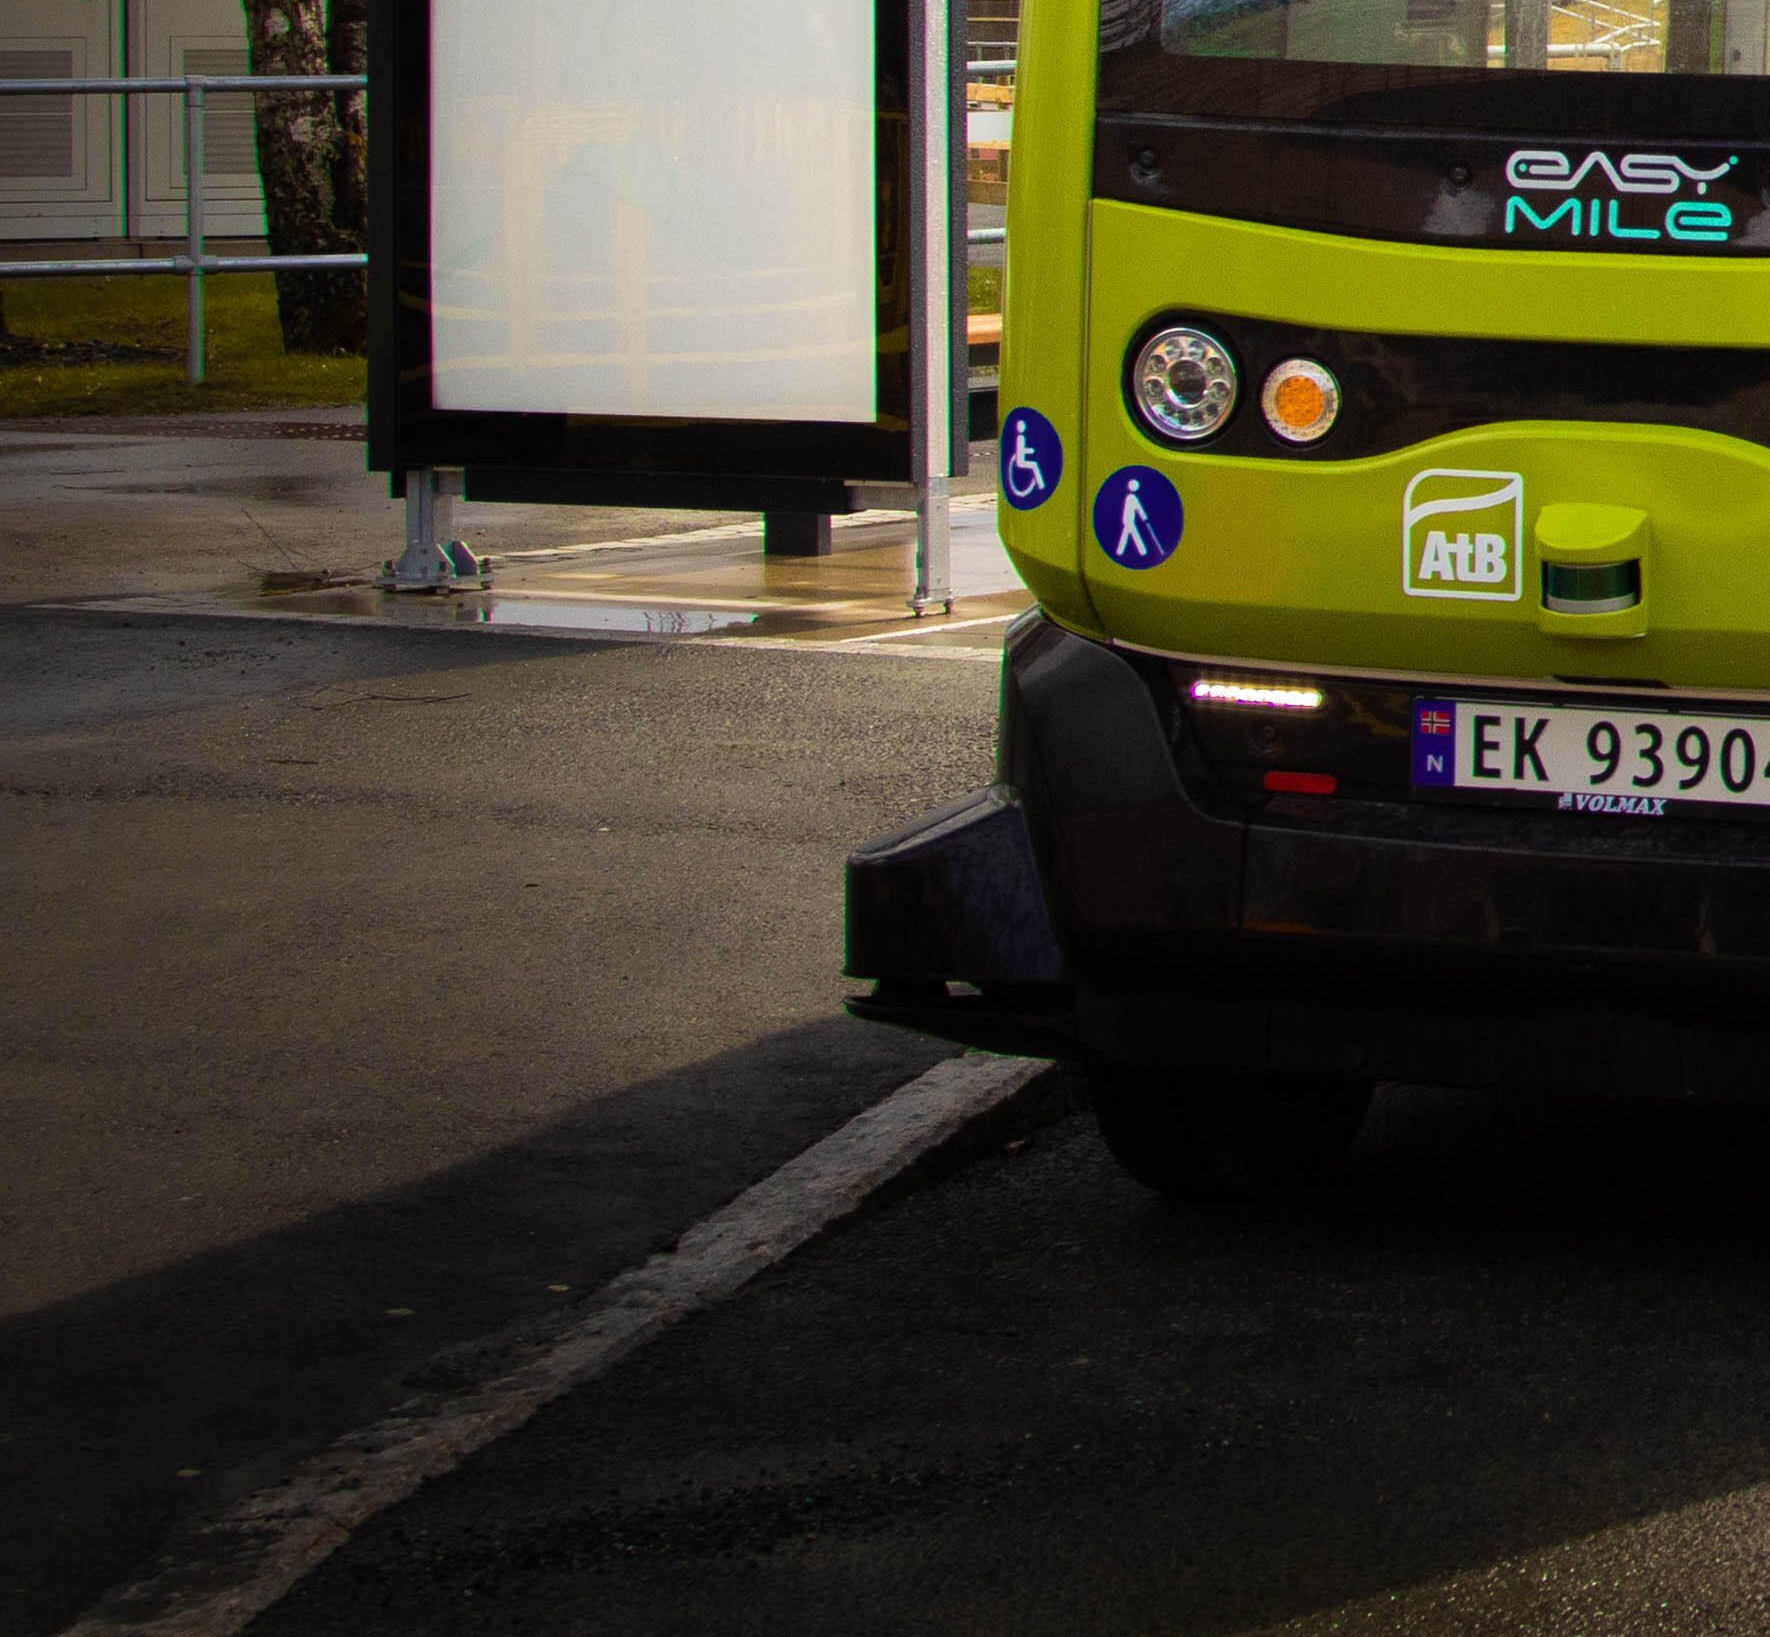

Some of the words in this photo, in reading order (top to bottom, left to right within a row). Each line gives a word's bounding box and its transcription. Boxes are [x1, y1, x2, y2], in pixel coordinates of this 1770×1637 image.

[1418, 531, 1507, 584] AtB
[1471, 714, 1551, 782] EK
[1574, 794, 1668, 816] VOLMAX
